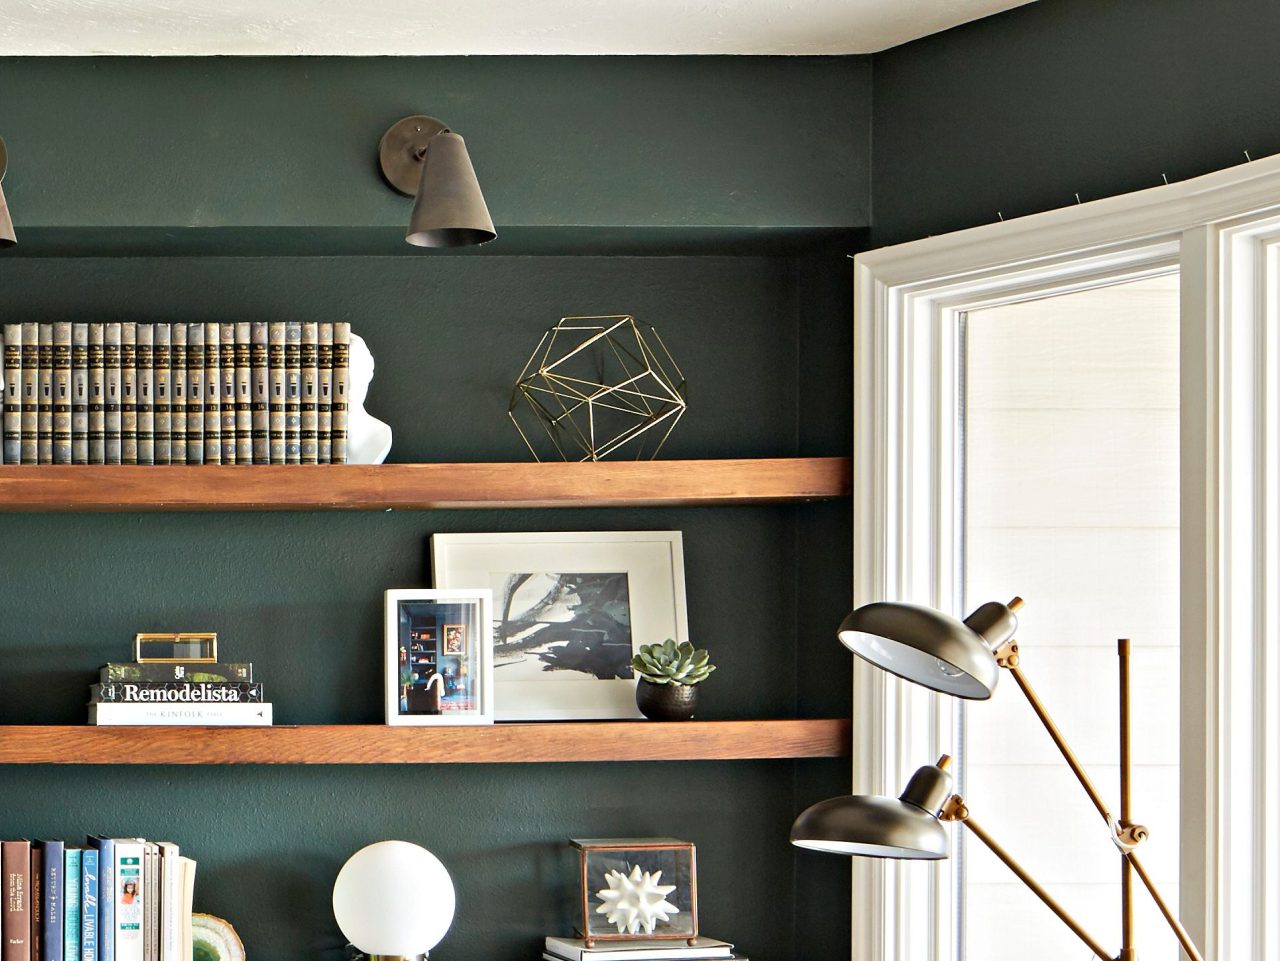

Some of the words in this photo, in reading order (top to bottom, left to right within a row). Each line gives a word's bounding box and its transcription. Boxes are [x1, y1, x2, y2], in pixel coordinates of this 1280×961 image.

[124, 683, 240, 702] Remodelista
[67, 879, 78, 907] YOUNG
[84, 867, 96, 914] lovable
[67, 910, 78, 938] HOUSE
[84, 914, 94, 945] LIVABLE
[67, 941, 78, 961] LOVE
